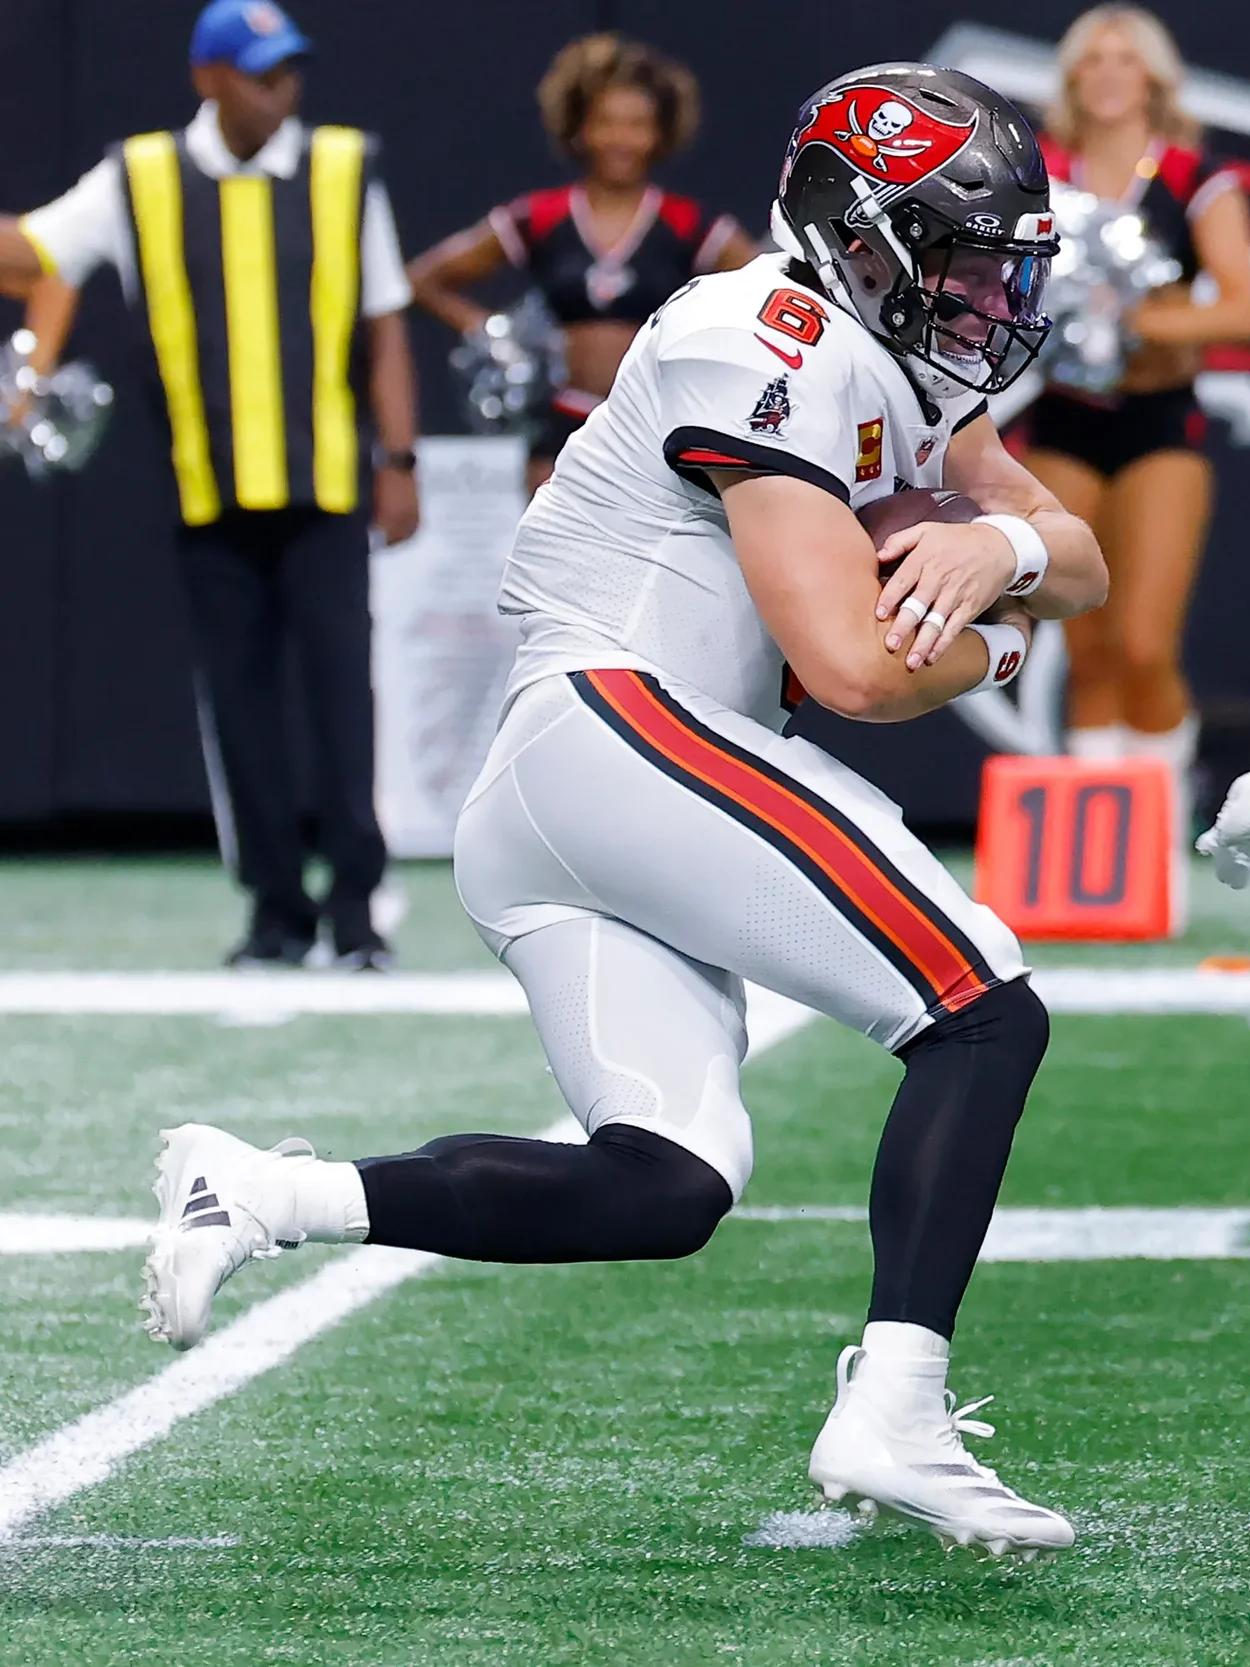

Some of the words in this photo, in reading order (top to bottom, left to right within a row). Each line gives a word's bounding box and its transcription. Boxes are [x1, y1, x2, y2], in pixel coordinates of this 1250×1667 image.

[965, 221, 1005, 235] OAKLEY
[756, 287, 831, 347] 6
[1021, 785, 1132, 905] 10
